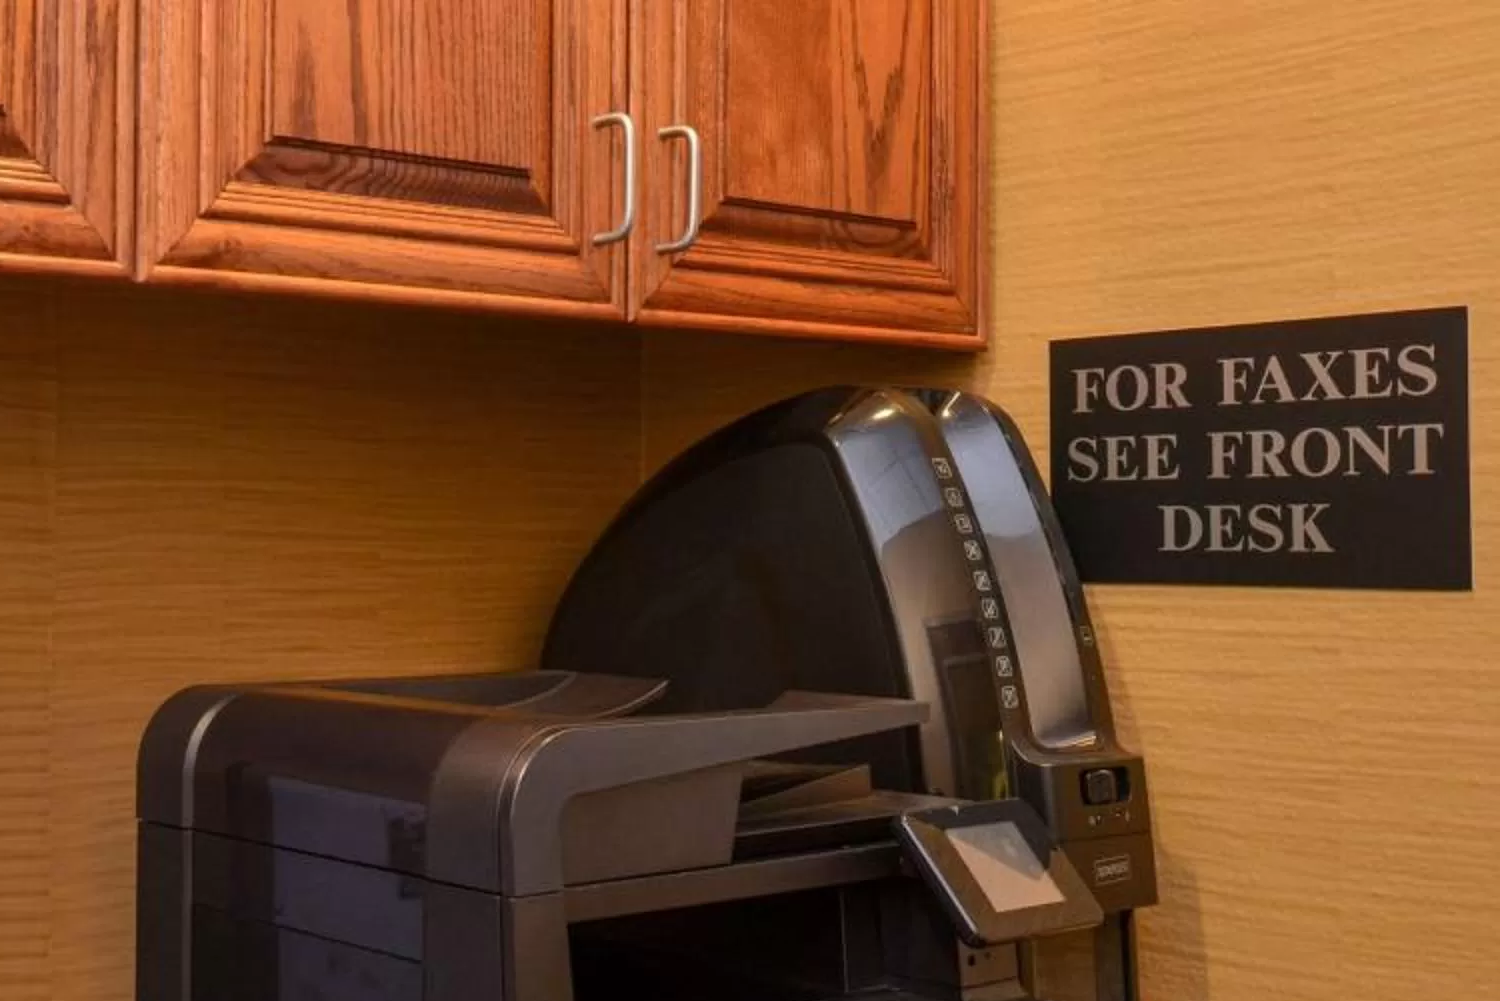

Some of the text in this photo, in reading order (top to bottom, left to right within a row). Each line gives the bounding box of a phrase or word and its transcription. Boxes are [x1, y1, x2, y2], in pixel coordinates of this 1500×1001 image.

[1071, 343, 1438, 415] FOR FAXES
[1067, 422, 1445, 484] SEE FRONT
[1156, 502, 1336, 554] DESK
